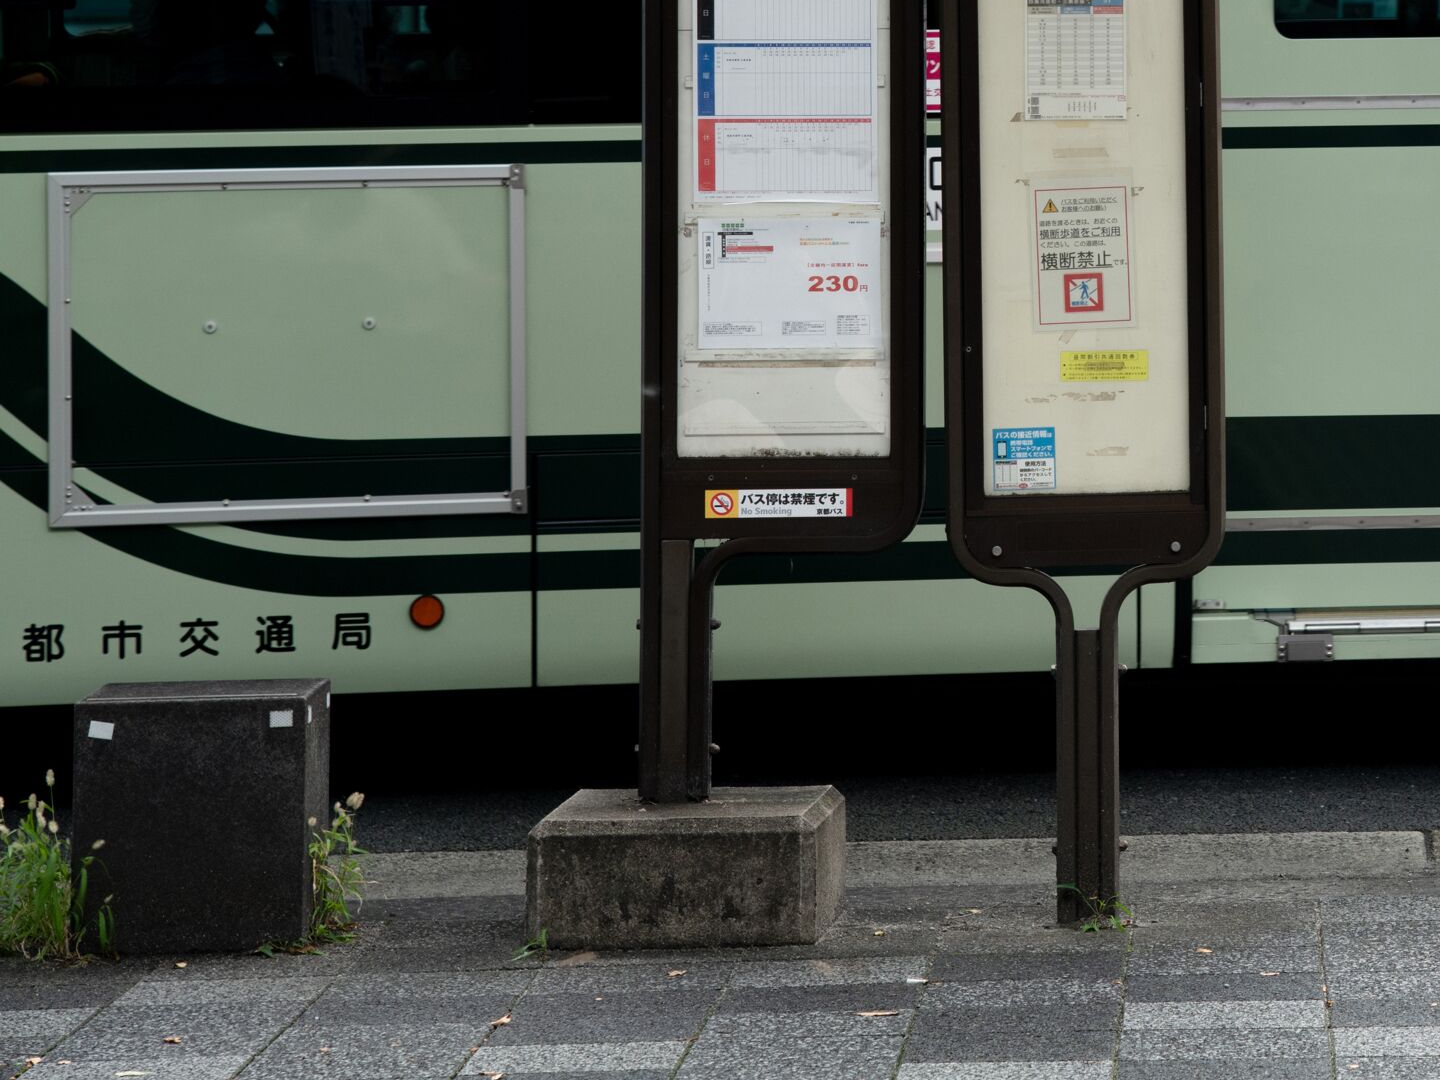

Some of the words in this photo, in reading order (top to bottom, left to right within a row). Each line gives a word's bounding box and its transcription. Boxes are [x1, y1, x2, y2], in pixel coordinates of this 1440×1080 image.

[1039, 226, 1121, 239] 横断歩道をご利用
[740, 491, 845, 506] バス停は禁煙です。
[740, 507, 752, 516] No
[754, 507, 793, 518] Smoking
[816, 507, 843, 516] 京都バス
[23, 611, 373, 662] 都市交通局
